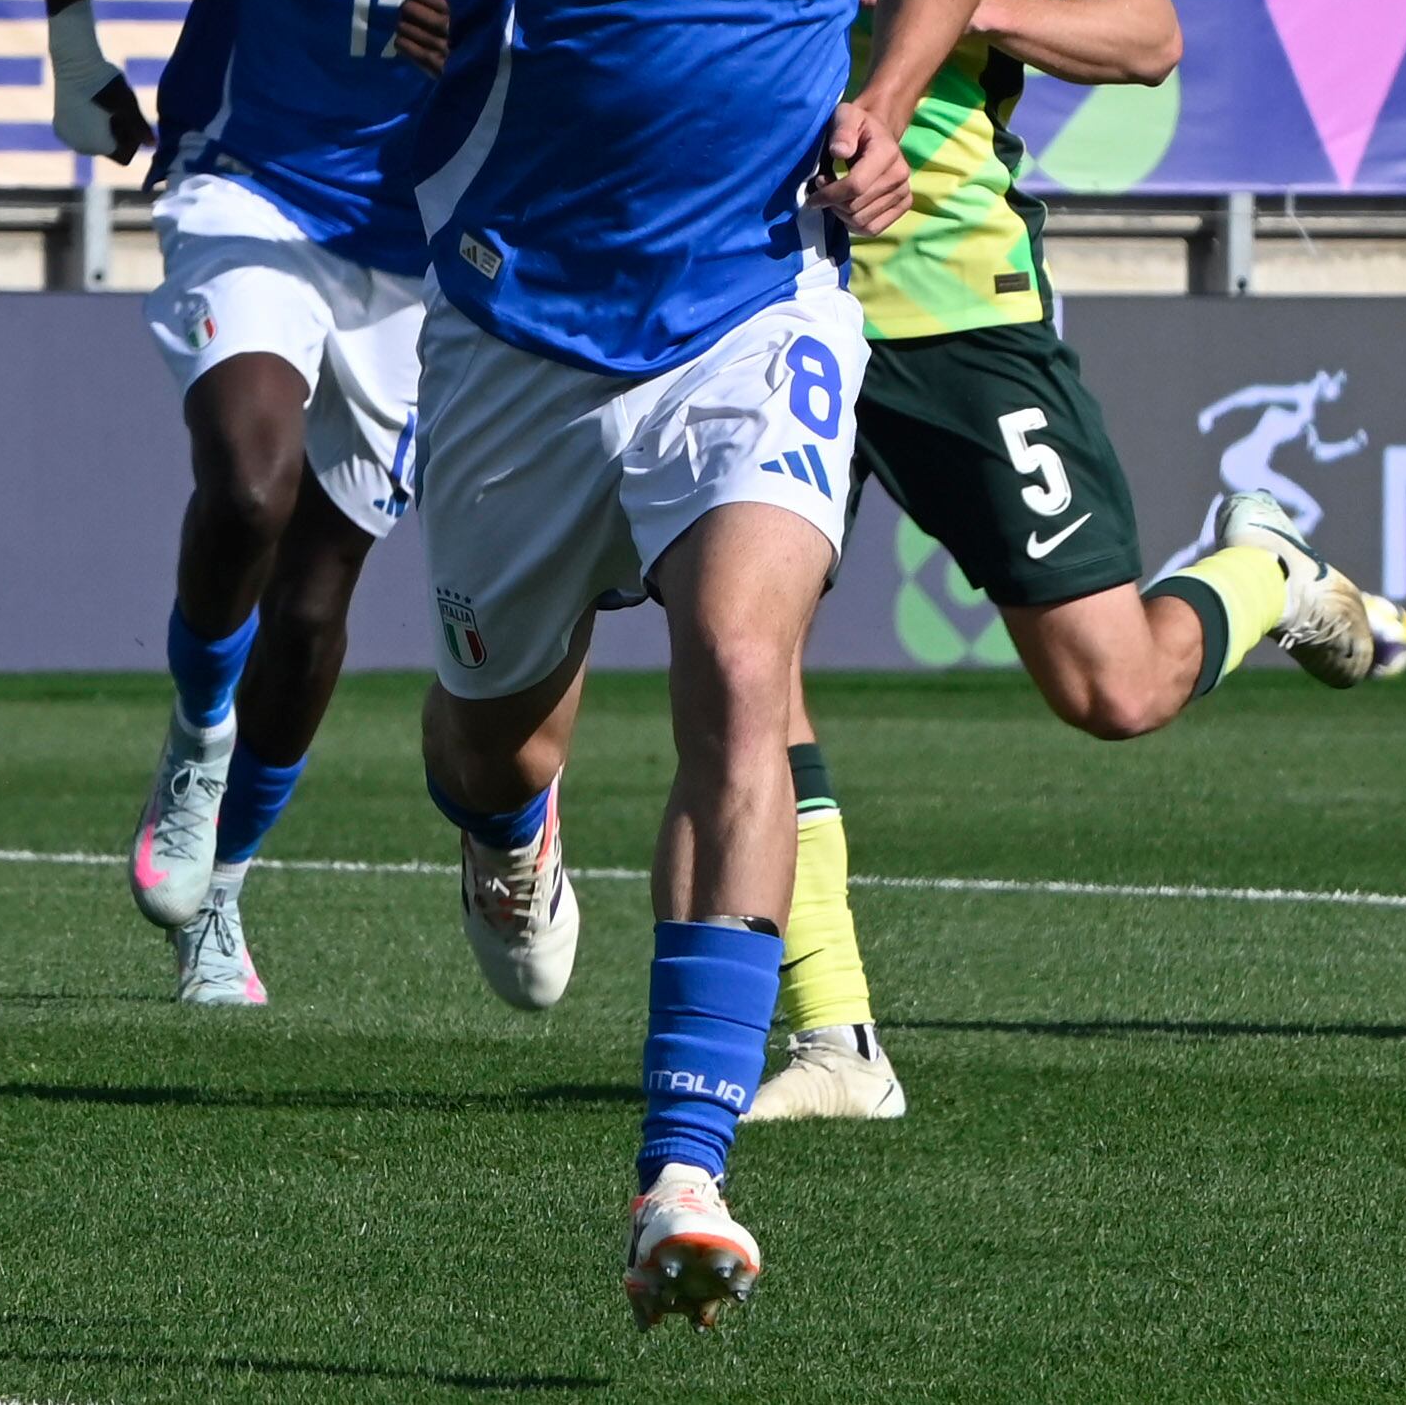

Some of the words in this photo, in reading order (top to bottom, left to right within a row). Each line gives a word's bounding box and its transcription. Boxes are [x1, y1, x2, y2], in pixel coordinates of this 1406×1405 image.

[785, 334, 843, 440] 8
[997, 406, 1073, 516] 5
[647, 1069, 747, 1109] ITALIA
